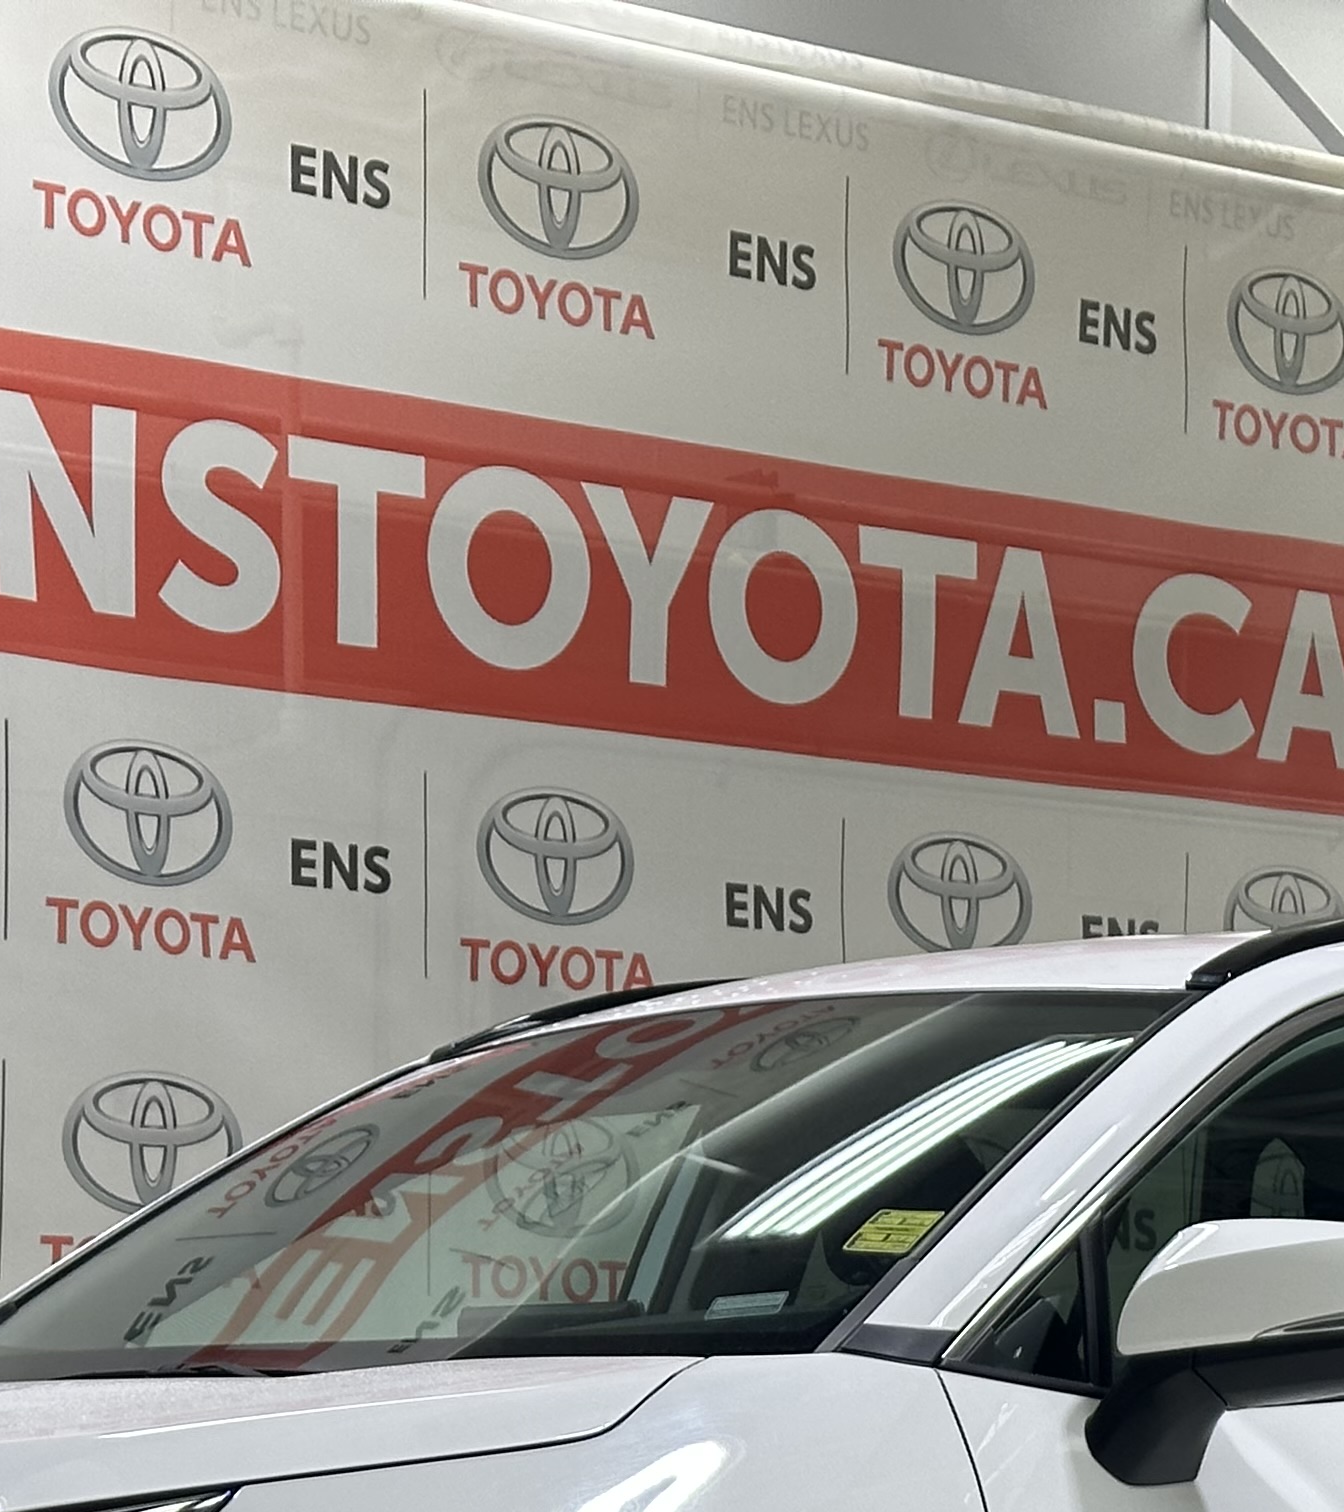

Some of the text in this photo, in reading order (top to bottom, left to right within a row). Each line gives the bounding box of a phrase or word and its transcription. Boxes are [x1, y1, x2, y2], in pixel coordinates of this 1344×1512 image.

[782, 107, 869, 151] LEXUS
[291, 145, 390, 209] ENS
[34, 181, 251, 266] TOYOTA
[729, 231, 816, 290] ENS
[460, 263, 653, 338] TOYOTA
[1079, 299, 1157, 354] ENS
[878, 339, 1047, 409] TOYOTA
[291, 838, 391, 894] ENS
[46, 897, 255, 963] TOYOTA
[725, 883, 812, 934] ENS
[460, 938, 654, 992] TOYOTA
[1114, 1206, 1157, 1252] NS
[461, 1254, 628, 1302] TOYOT
